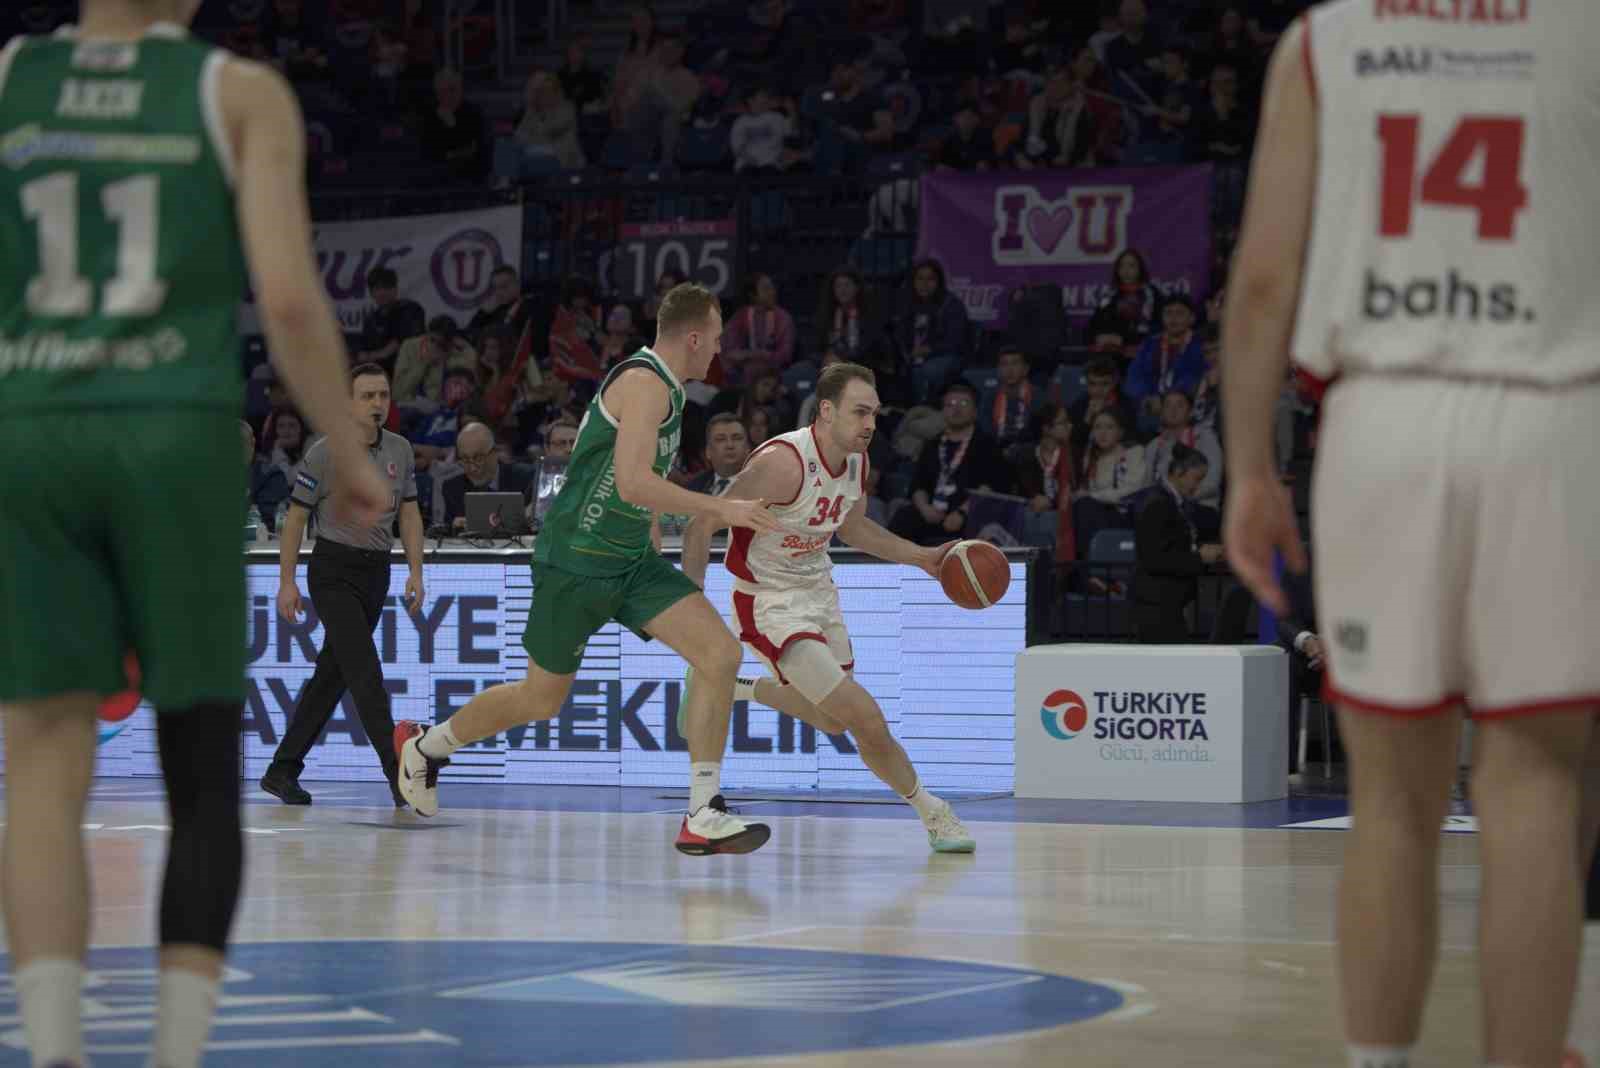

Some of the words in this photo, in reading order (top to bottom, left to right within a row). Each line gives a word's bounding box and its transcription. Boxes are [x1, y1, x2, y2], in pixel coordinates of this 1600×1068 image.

[1376, 114, 1528, 240] 14
[19, 172, 168, 317] 11
[628, 241, 728, 296] 105
[808, 495, 845, 526] 34
[1100, 744, 1148, 763] Gücü,
